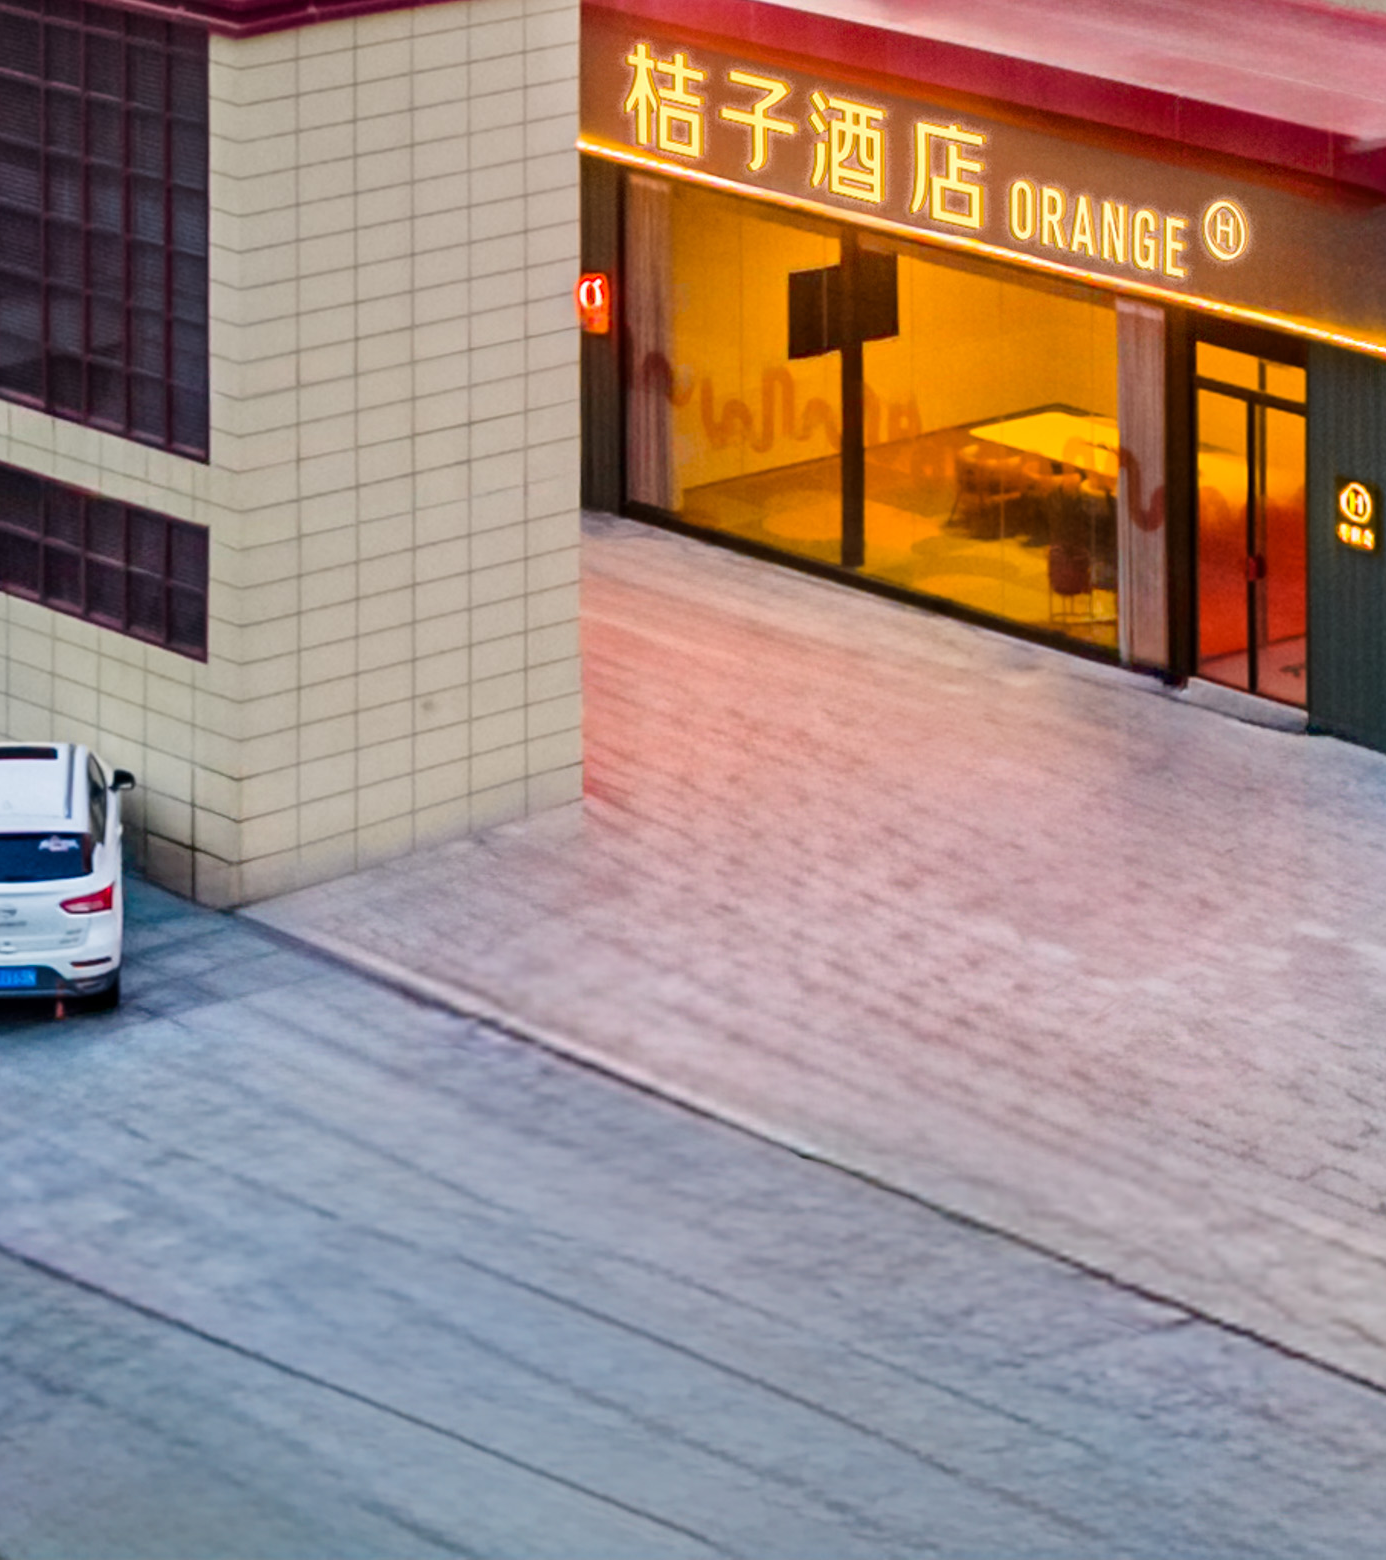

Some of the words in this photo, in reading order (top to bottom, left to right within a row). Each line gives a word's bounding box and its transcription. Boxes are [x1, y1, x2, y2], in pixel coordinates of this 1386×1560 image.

[624, 43, 987, 230] 桔子酒店
[1009, 179, 1189, 279] ORANGE
